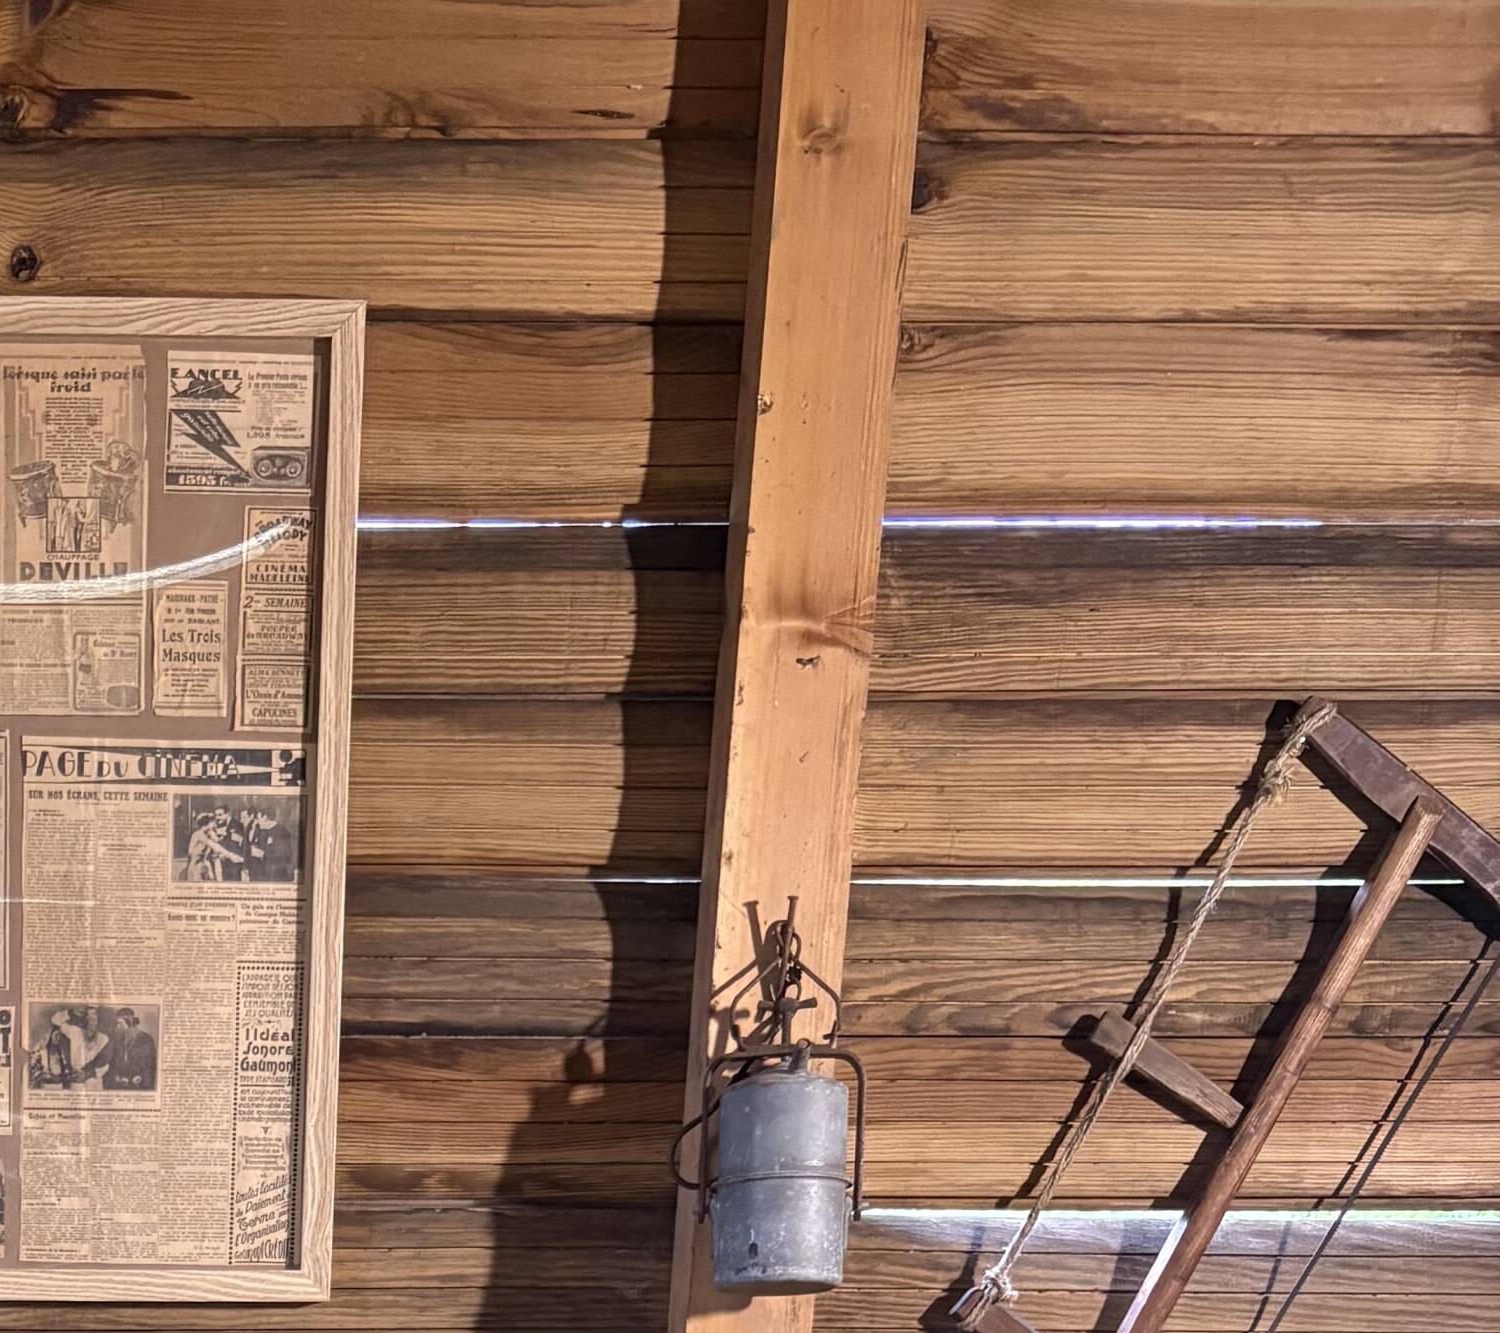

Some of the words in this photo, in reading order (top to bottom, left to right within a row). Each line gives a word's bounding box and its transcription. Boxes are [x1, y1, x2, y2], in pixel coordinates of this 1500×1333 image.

[20, 562, 128, 581] DEVILLE
[161, 629, 184, 644] Les
[187, 628, 221, 644] Trois
[161, 647, 221, 664] Masques
[22, 750, 93, 778] PAGE
[28, 790, 45, 801] SUR
[47, 790, 63, 801] NOS
[103, 791, 130, 802] CETTE
[133, 791, 168, 802] SEMAINE
